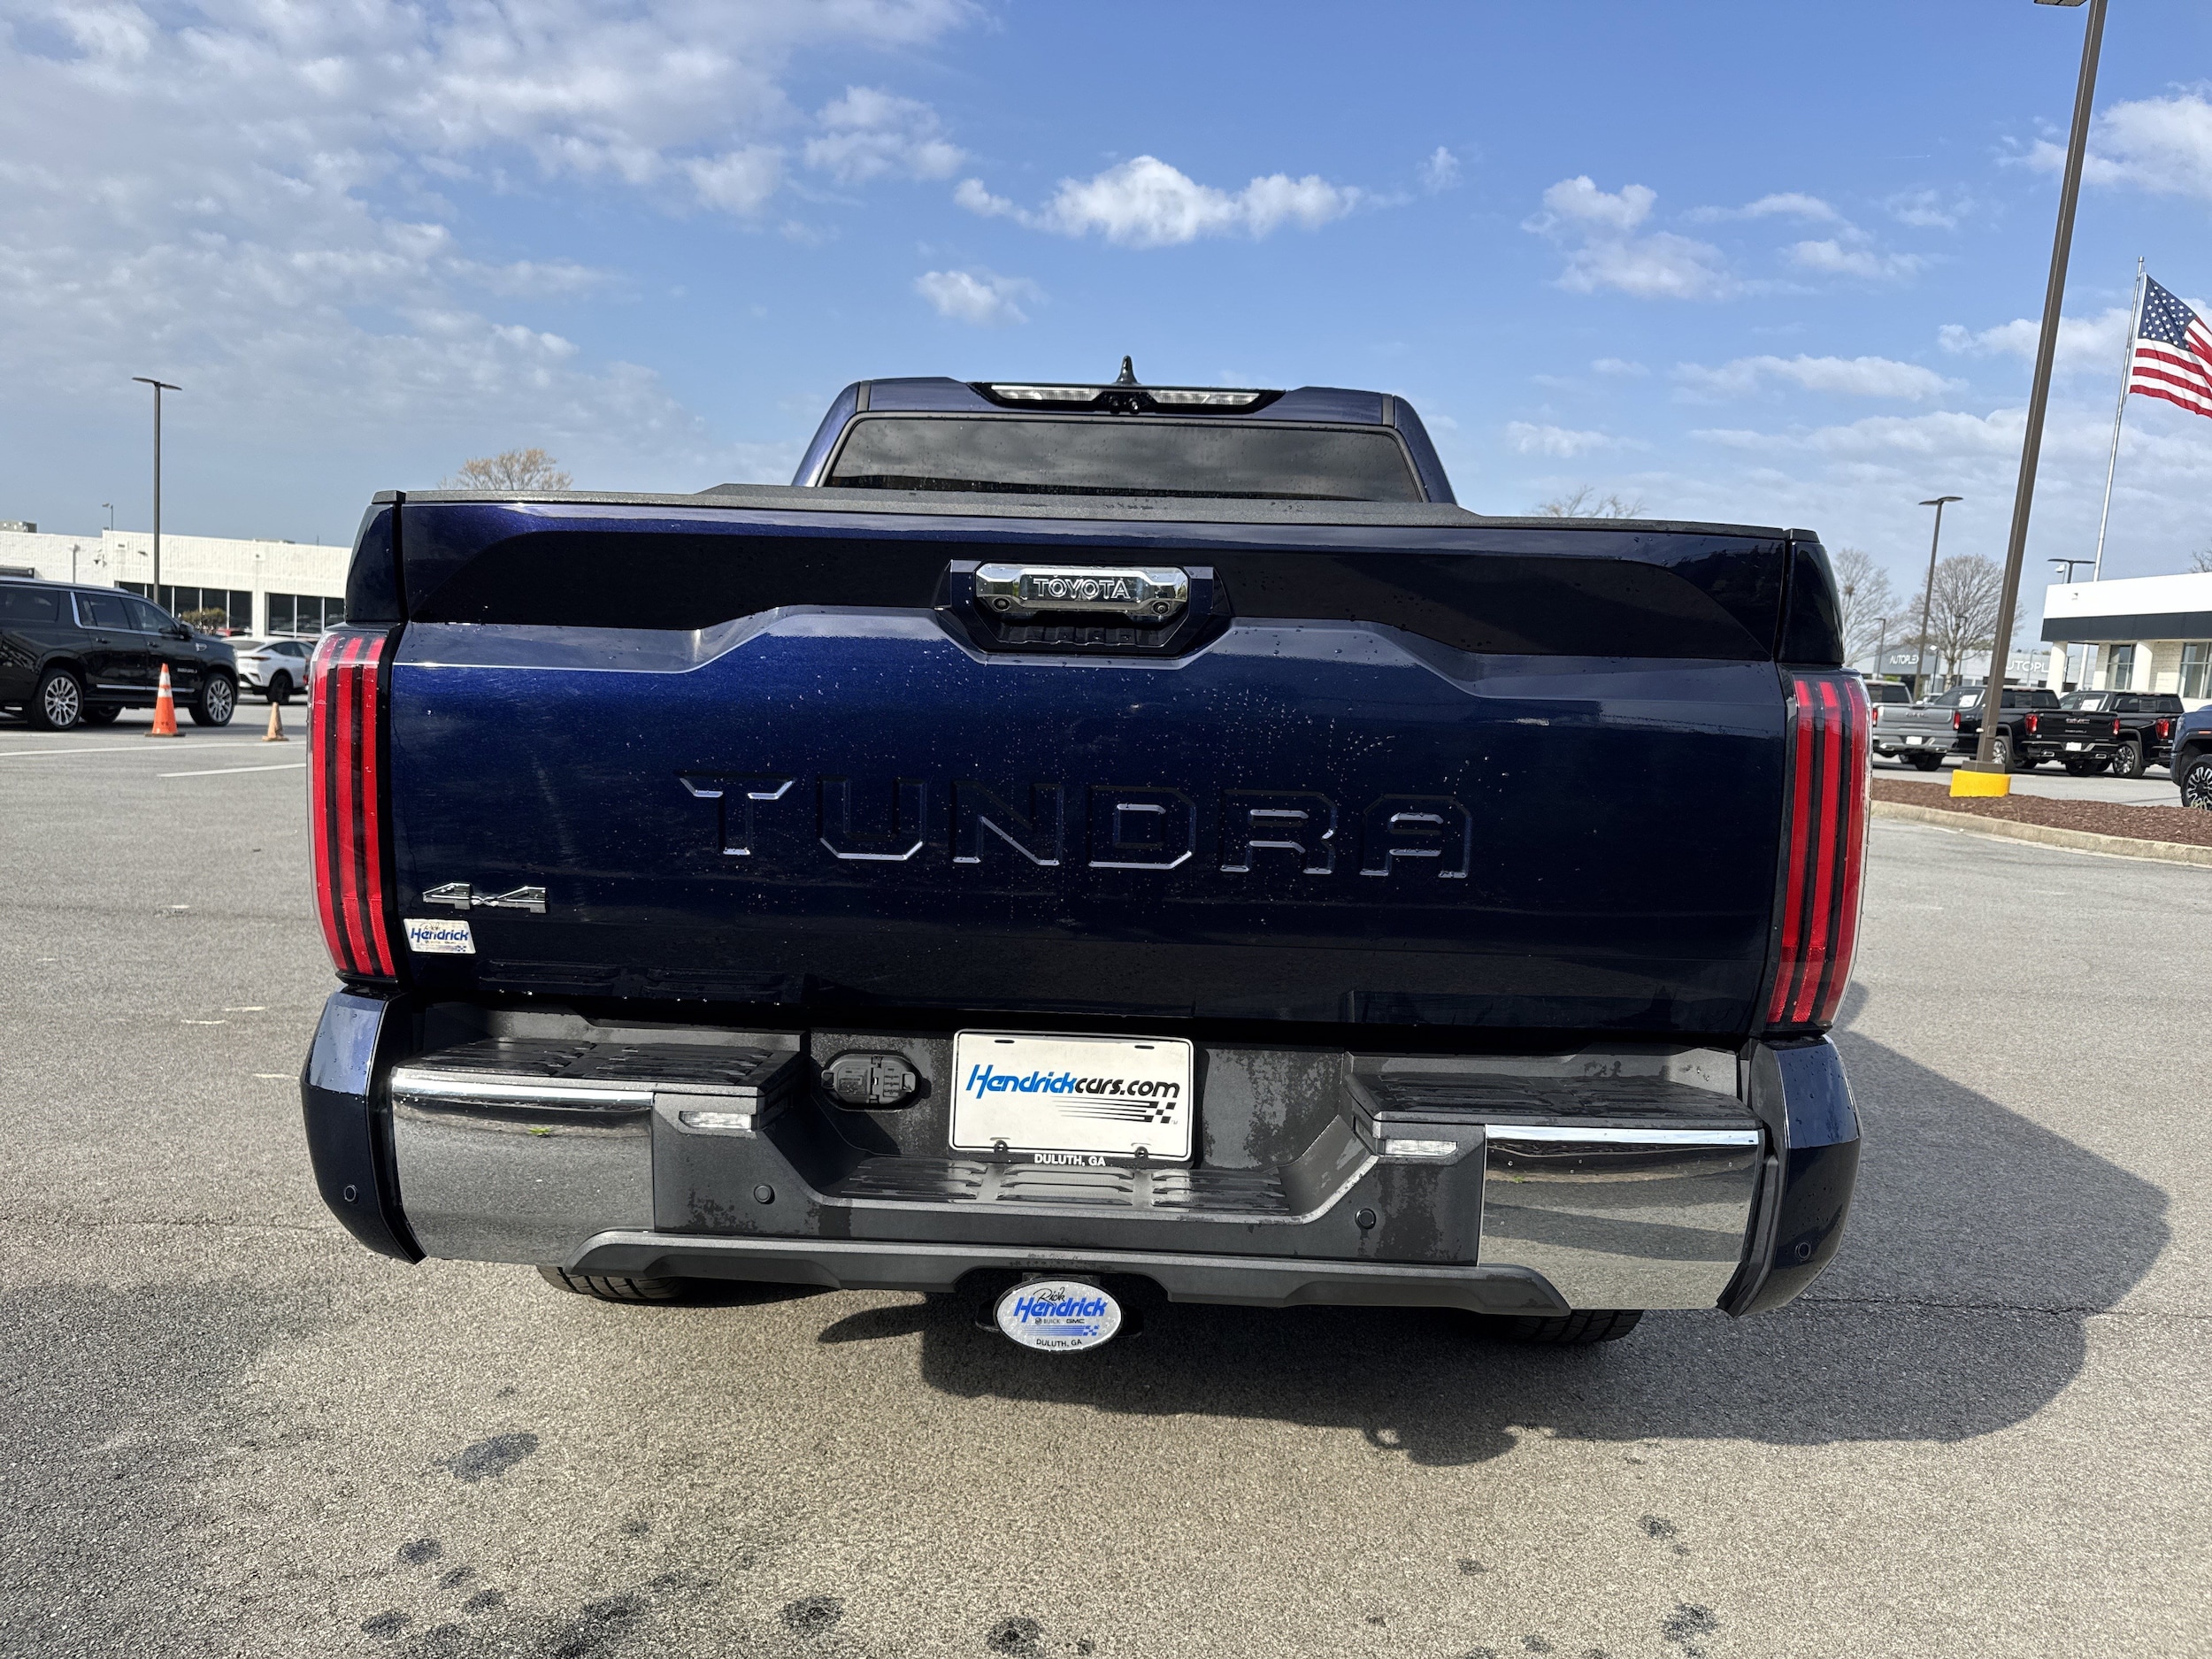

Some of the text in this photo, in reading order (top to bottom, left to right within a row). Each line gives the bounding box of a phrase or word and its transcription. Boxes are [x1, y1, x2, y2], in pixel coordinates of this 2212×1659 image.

[1033, 578, 1131, 600] TOYOTA
[2006, 660, 2049, 674] UTOPL
[677, 772, 1471, 880] TUNDRA
[411, 928, 469, 943] Hendrick
[965, 1064, 1180, 1099] Hendrickcars.com
[1033, 1154, 1106, 1167] DULUTH, GA
[1033, 1286, 1066, 1307] Rick
[1013, 1297, 1108, 1323] Hendrick
[1036, 1338, 1069, 1348] DULUTH,
